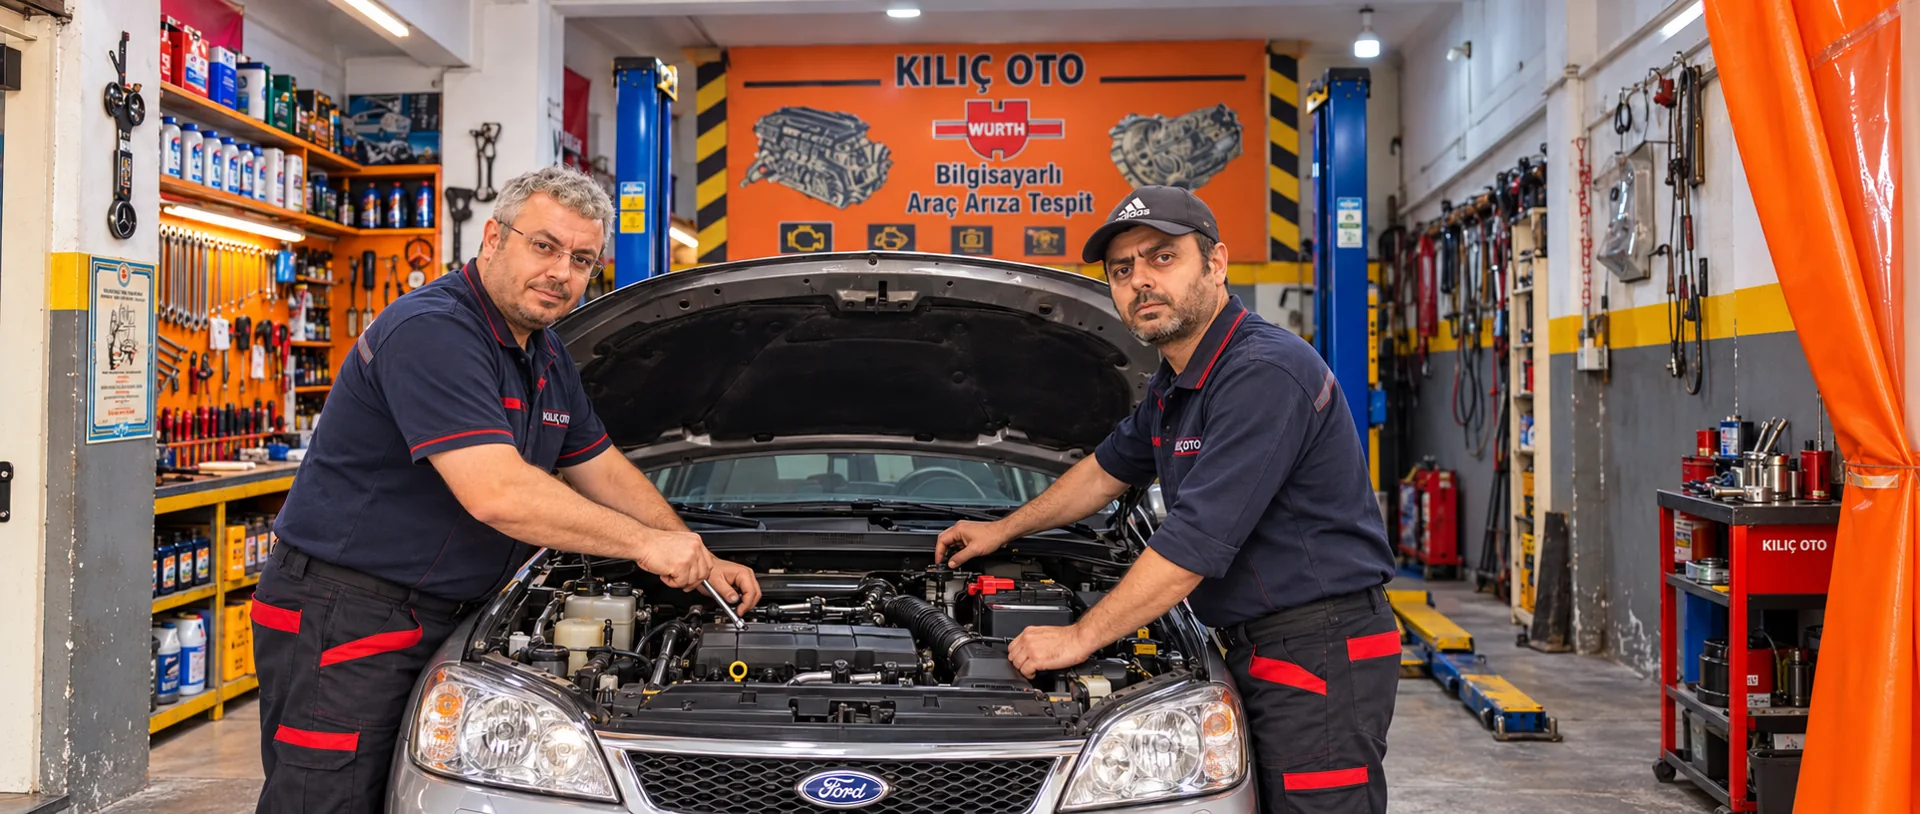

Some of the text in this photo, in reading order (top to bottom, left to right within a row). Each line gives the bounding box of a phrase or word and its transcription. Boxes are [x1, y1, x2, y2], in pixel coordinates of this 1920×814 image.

[895, 53, 1085, 93] KILIÇ OTO
[968, 122, 1025, 136] WURTH
[936, 163, 1062, 188] Bilgisayarlı
[907, 191, 1093, 217] Araç Arıza Tespit
[1183, 440, 1201, 450] OTO
[1762, 540, 1828, 554] KILIÇ OTO
[818, 777, 867, 799] Ford
